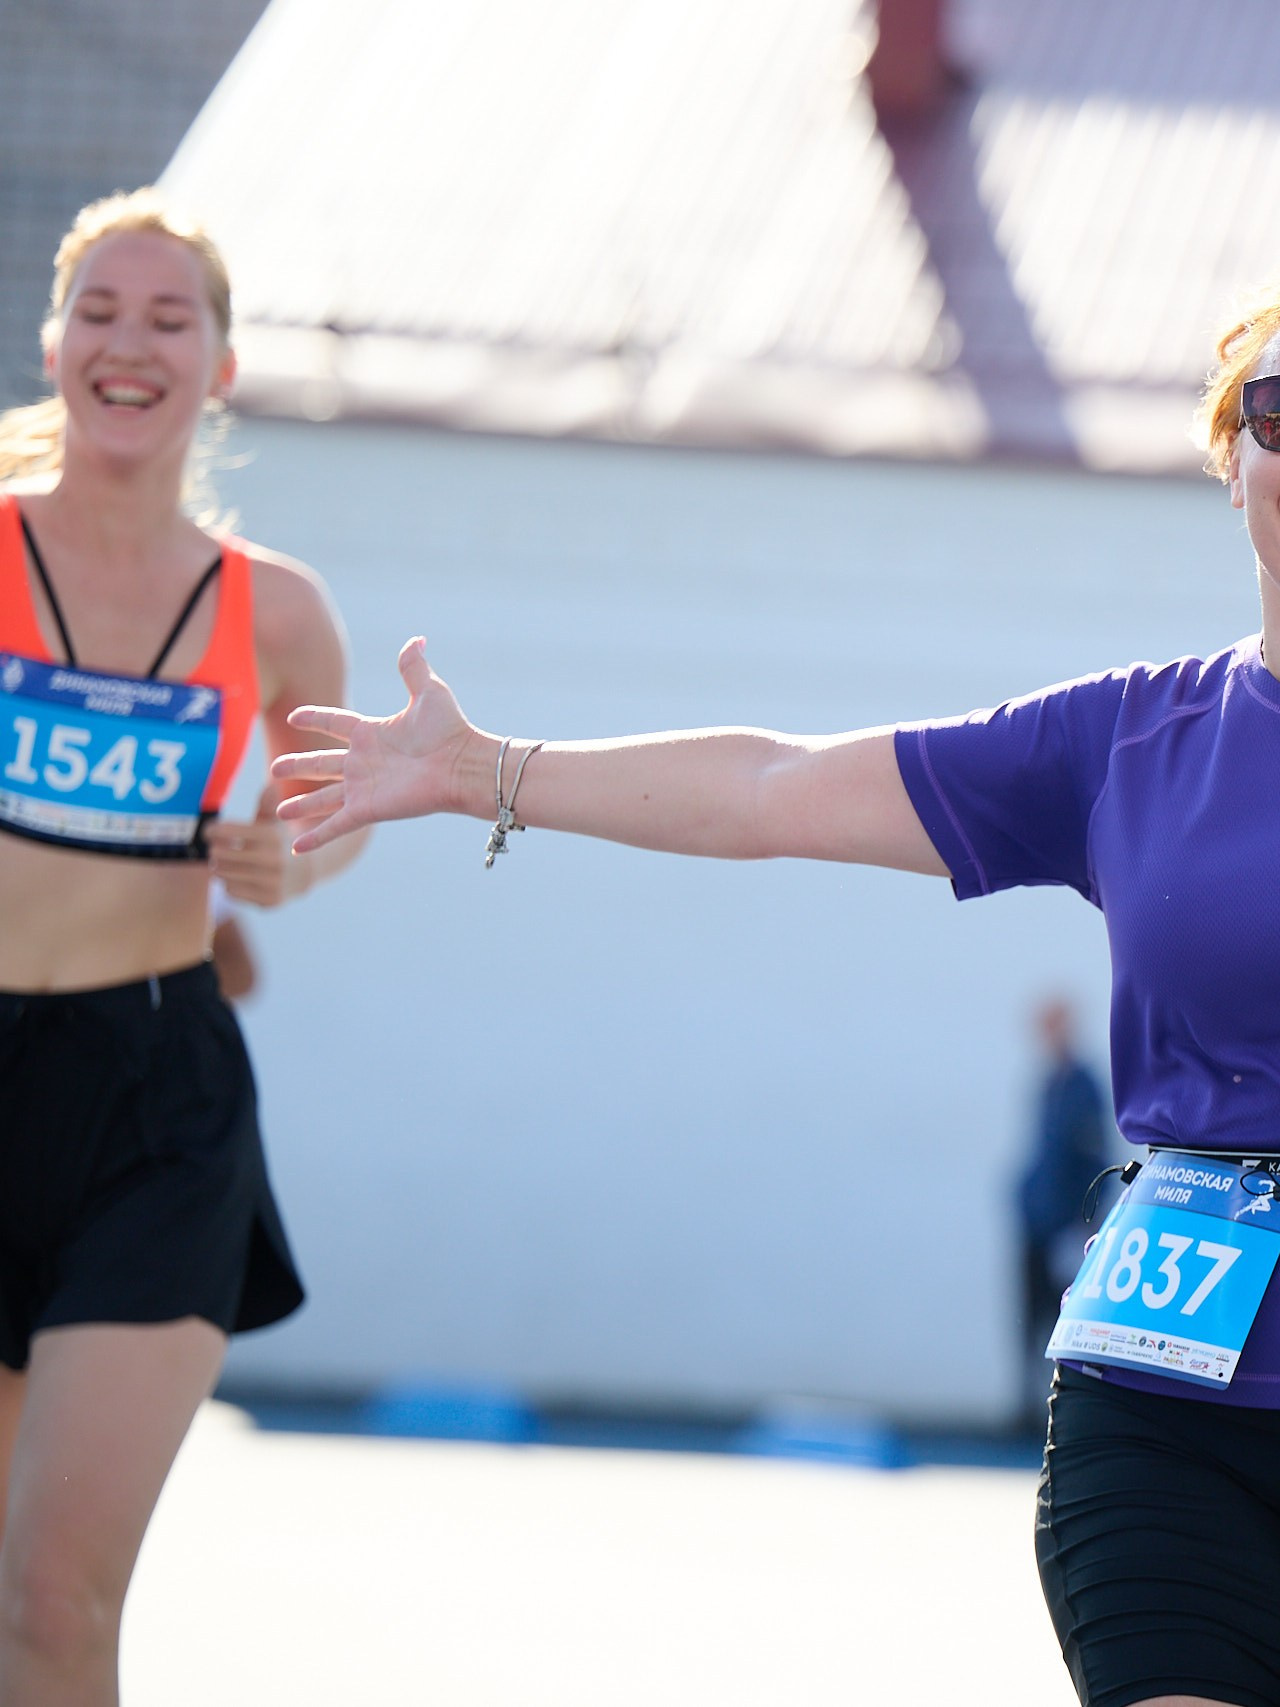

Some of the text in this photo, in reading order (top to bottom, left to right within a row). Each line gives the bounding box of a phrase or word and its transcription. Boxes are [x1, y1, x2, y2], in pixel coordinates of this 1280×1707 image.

[4, 716, 187, 804] 1543
[1153, 1185, 1193, 1205] МИЛЯ
[1082, 1226, 1243, 1316] 1837
